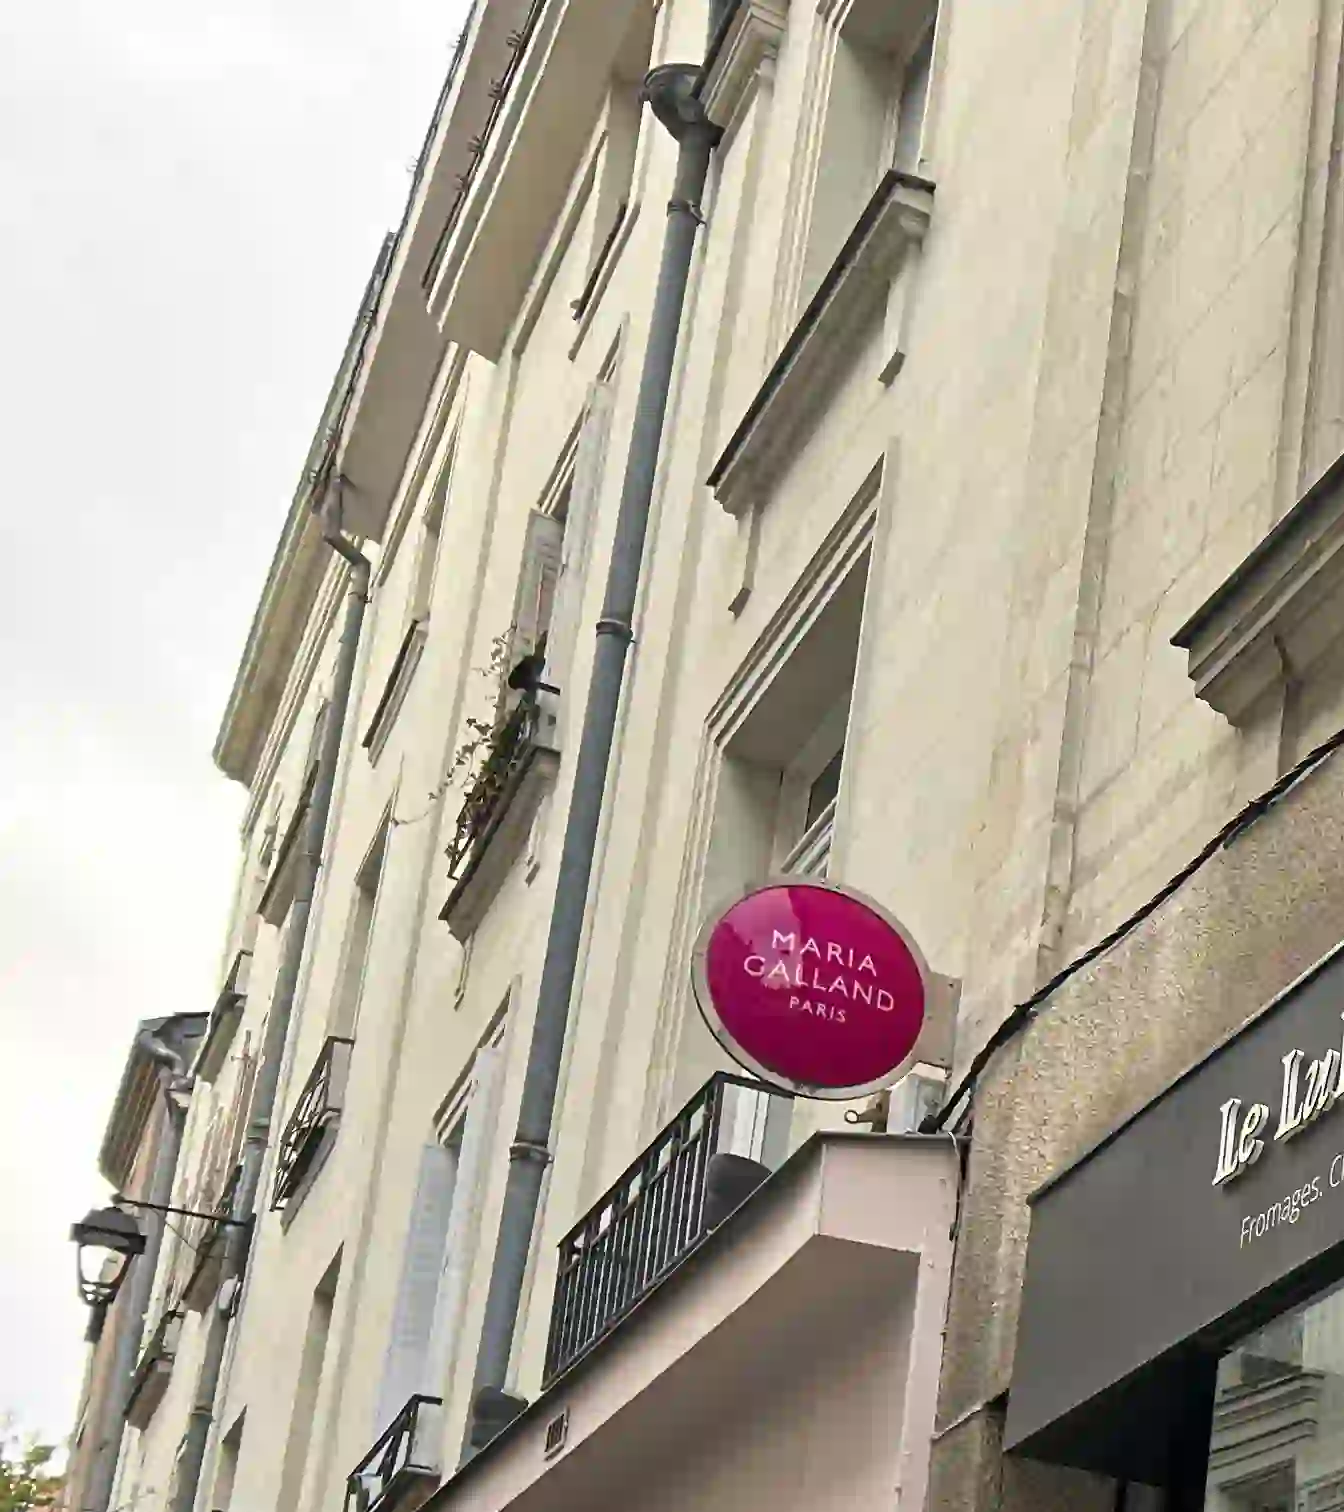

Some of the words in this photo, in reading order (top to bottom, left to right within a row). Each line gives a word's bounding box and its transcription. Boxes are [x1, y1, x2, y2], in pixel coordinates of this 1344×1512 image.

[771, 929, 878, 977] MARIA
[743, 955, 894, 1012] GALLAND
[789, 995, 847, 1023] PARIS
[1212, 1097, 1270, 1186] Le
